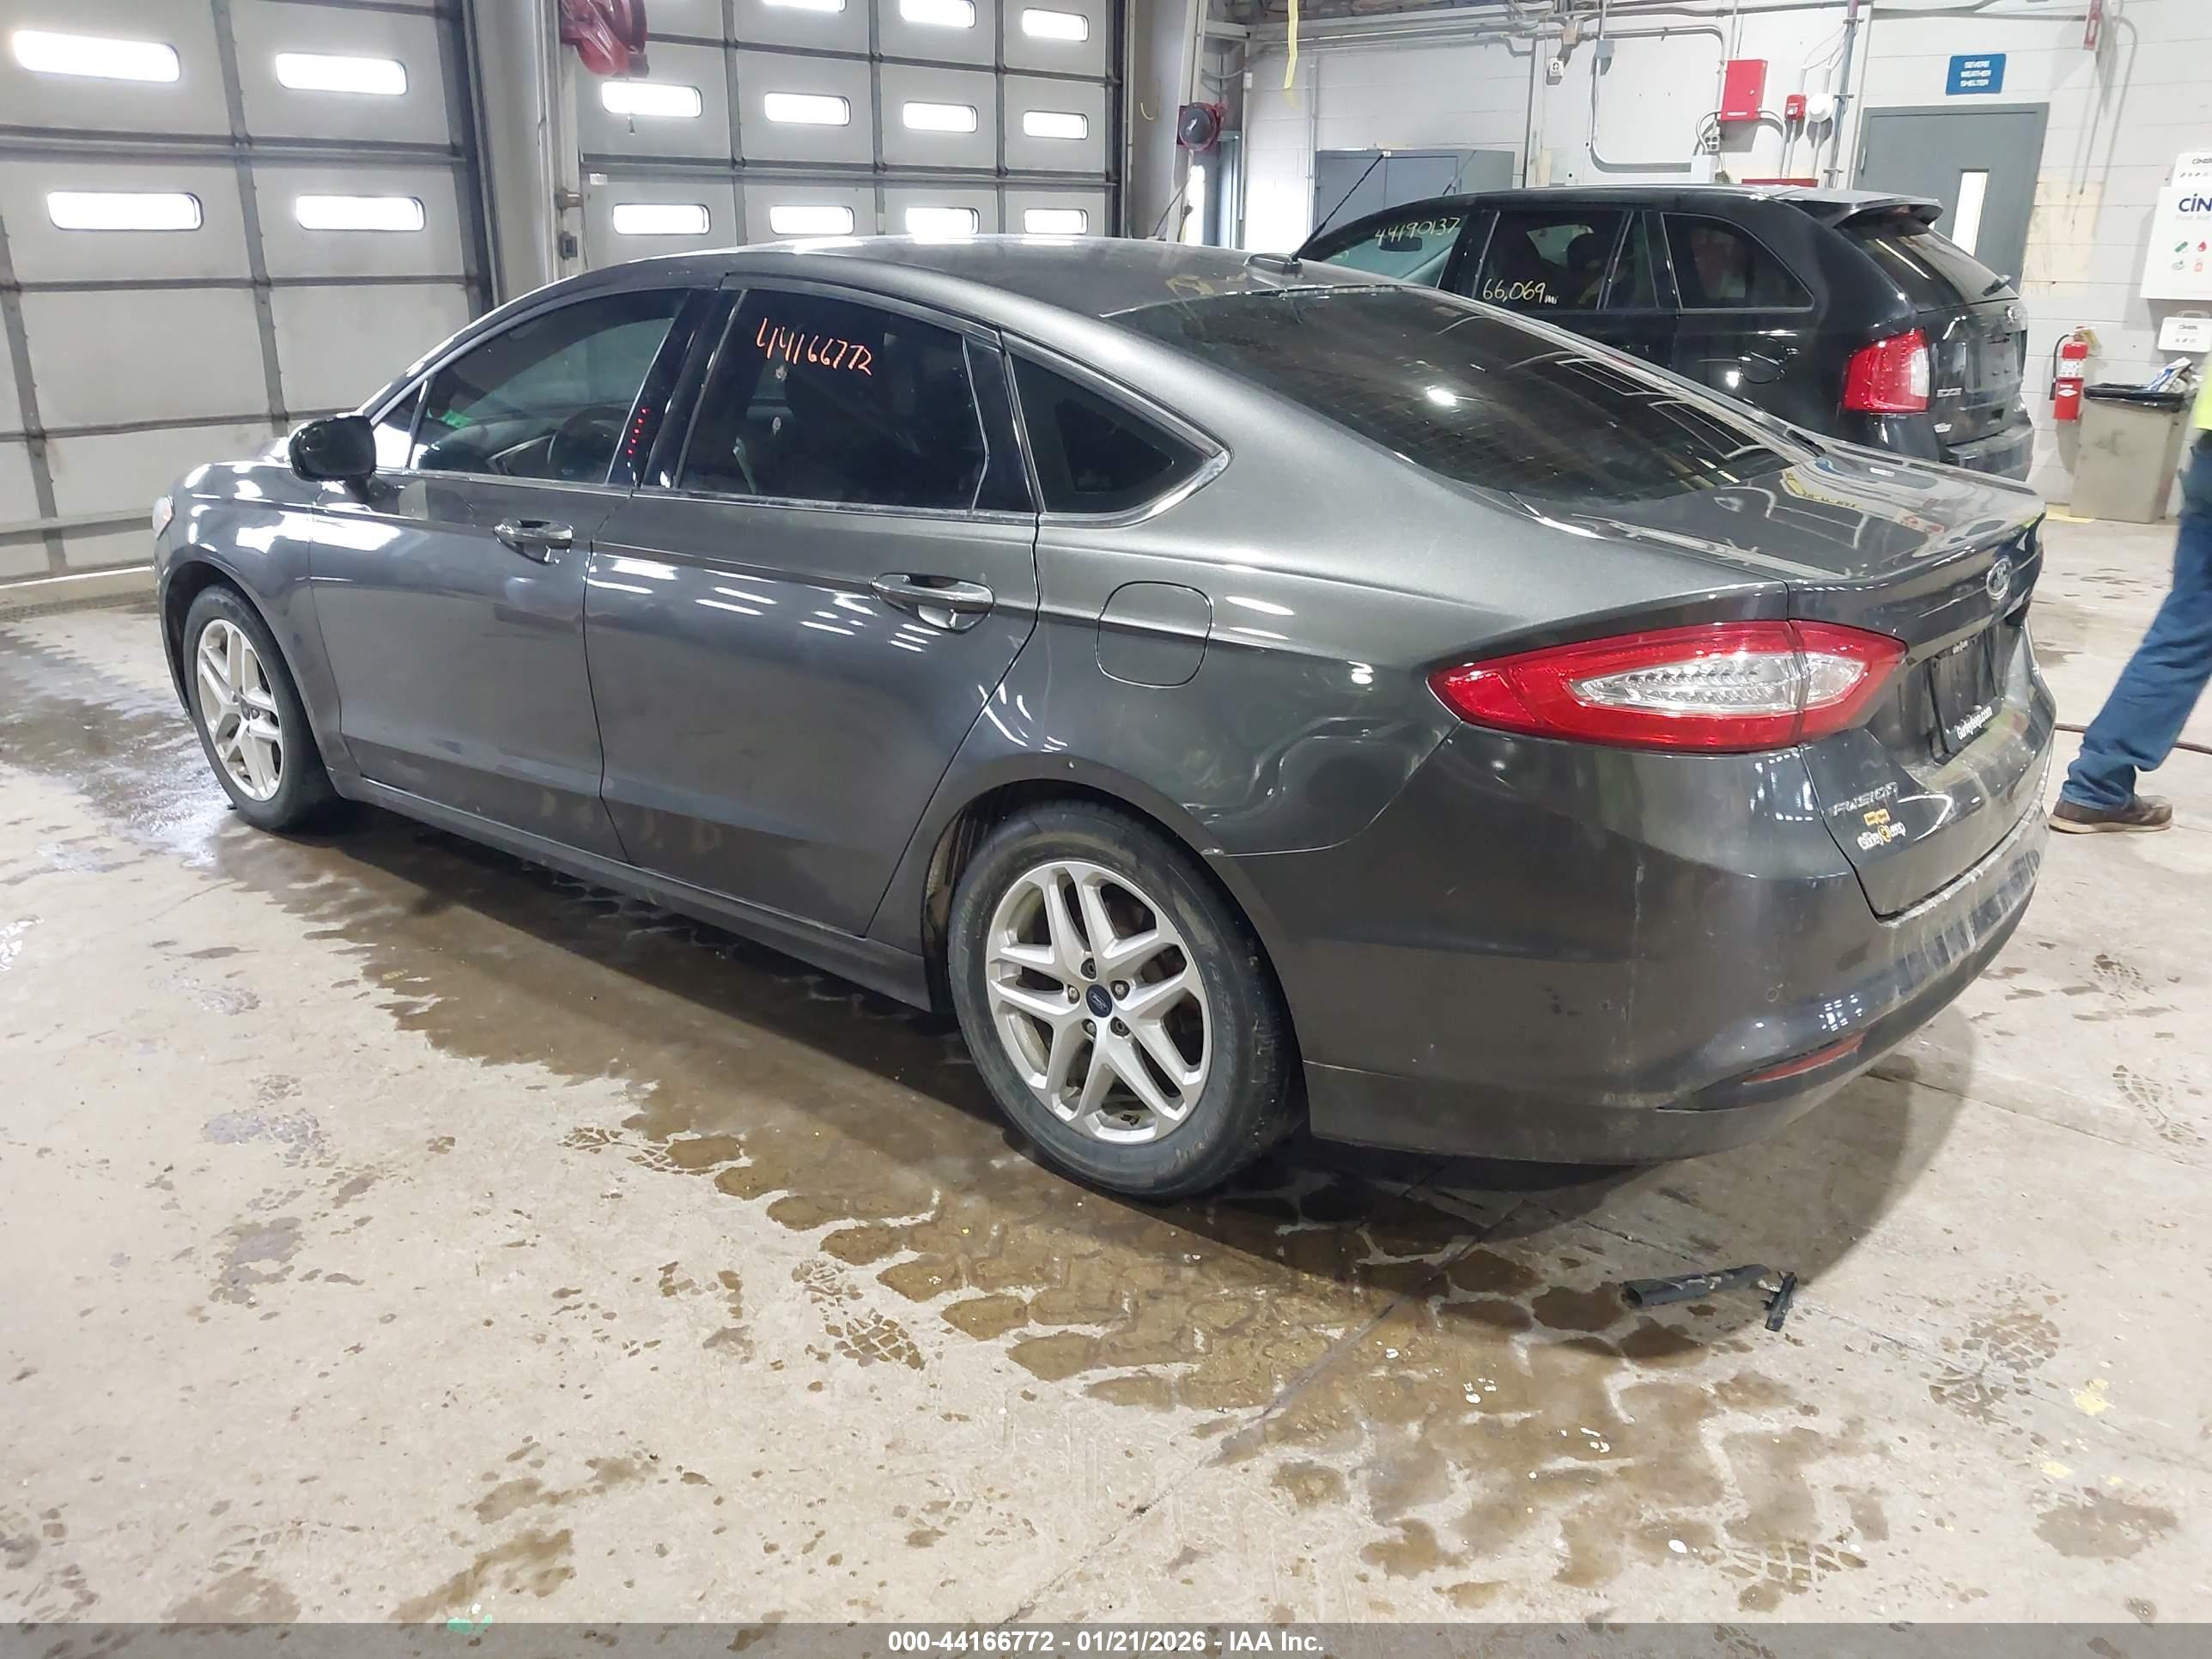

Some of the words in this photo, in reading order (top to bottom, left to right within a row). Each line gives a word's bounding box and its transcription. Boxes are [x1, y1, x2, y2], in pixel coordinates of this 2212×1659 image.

[1374, 216, 1462, 247] 44190137
[1482, 277, 1546, 304] 66,069
[756, 316, 873, 376] 44166772
